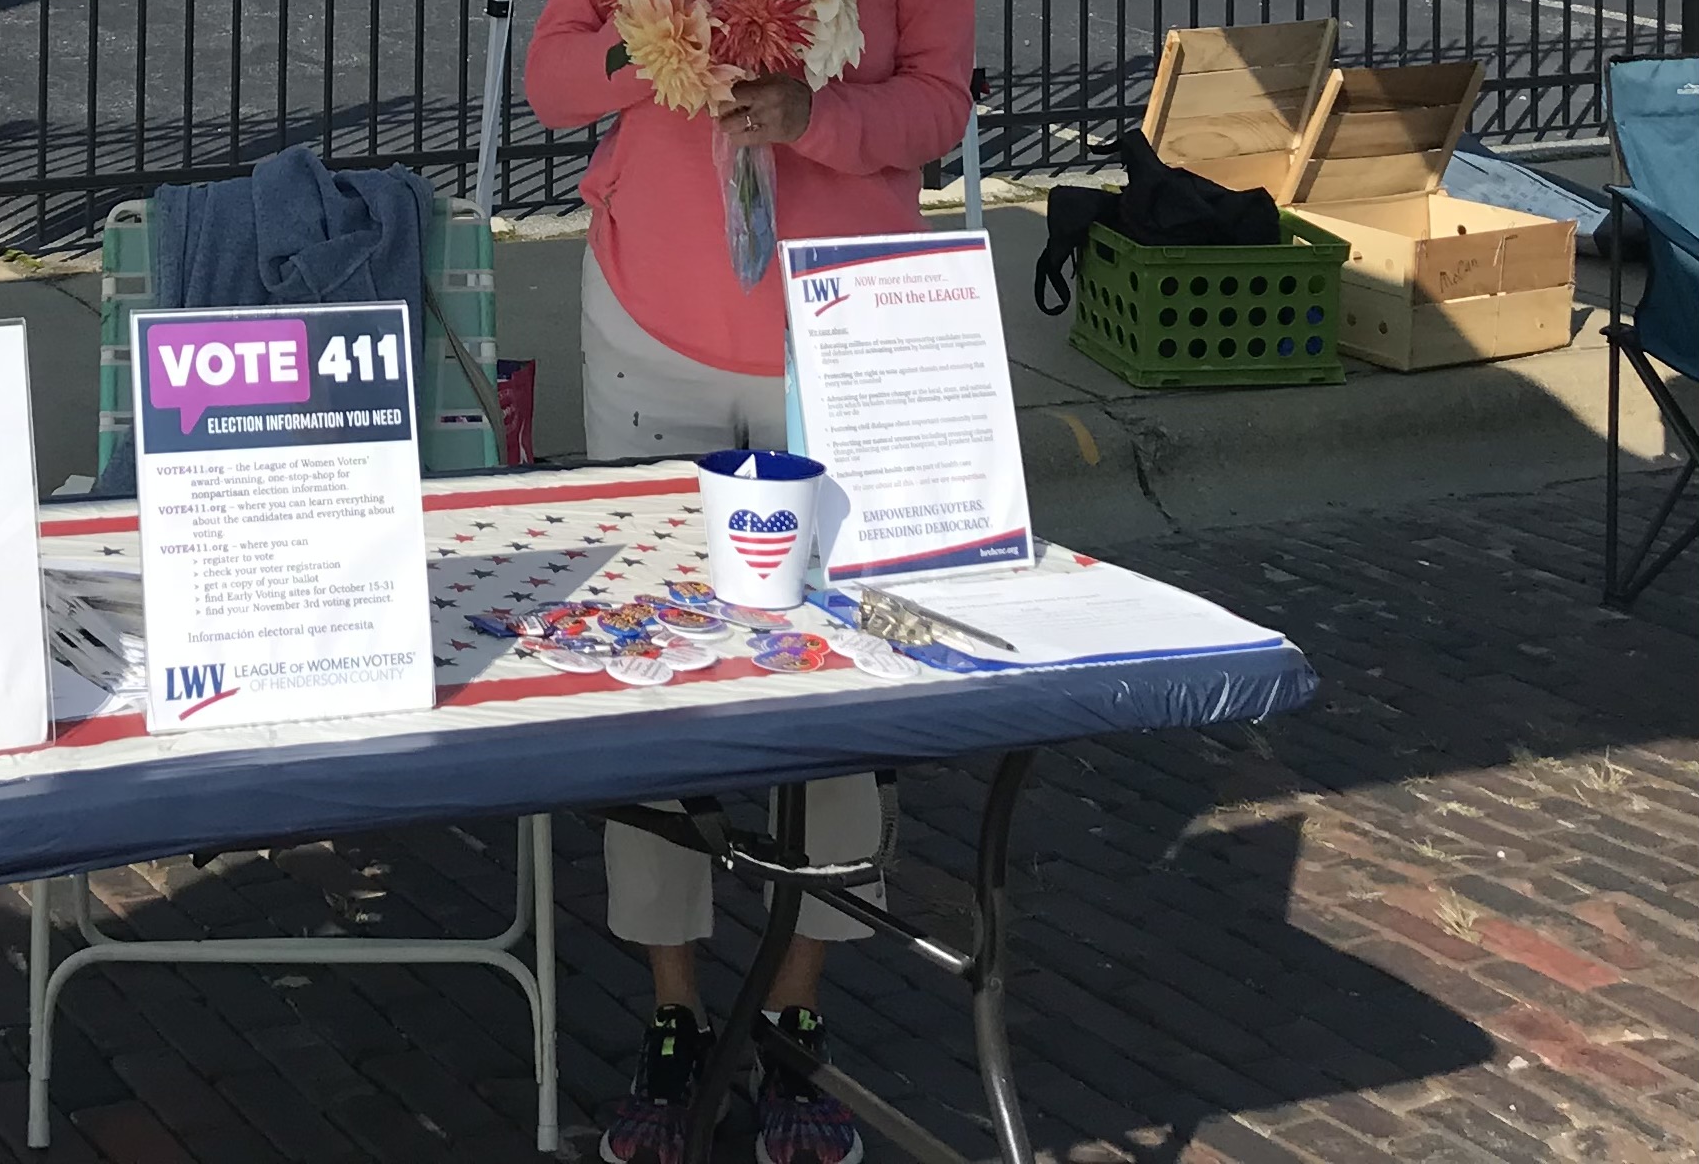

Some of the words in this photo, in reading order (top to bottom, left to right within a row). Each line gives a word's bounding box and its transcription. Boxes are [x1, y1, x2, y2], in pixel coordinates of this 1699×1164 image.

[802, 277, 841, 304] LWV
[854, 276, 877, 287] NOW
[878, 276, 901, 285] more
[902, 273, 923, 284] than
[874, 292, 903, 308] JOIN
[905, 290, 925, 304] the
[928, 287, 980, 302] LEAGUE.
[158, 341, 299, 386] VOTE
[318, 334, 399, 382] 411
[207, 416, 263, 434] ELECTION
[266, 412, 344, 430] INFORMATION
[346, 410, 370, 427] YOU
[372, 409, 402, 425] NEED
[156, 465, 225, 475] VOTE411.org
[235, 462, 251, 472] the
[254, 462, 287, 472] League
[289, 459, 299, 469] of
[300, 459, 335, 468] Women
[268, 471, 335, 483] one-stop-shop
[337, 469, 350, 479] for
[191, 489, 250, 501] nonpartisan
[252, 486, 289, 495] election
[158, 504, 227, 515] VOTE411.org
[237, 501, 266, 510] where
[268, 501, 286, 511] you
[288, 500, 306, 508] can
[309, 497, 333, 506] learn
[336, 494, 385, 506] everything
[862, 503, 939, 522] EMPOWERING
[940, 499, 985, 514] VOTERS.
[192, 516, 220, 526] about
[223, 515, 239, 524] the
[241, 512, 293, 523] candidates
[295, 509, 314, 520] and
[316, 507, 366, 519] everything
[368, 505, 395, 515] about
[858, 524, 923, 541] DEFENDING
[924, 517, 993, 534] DEMOCRACY.
[160, 544, 229, 554] VOTE411.org
[239, 540, 268, 549] where
[271, 540, 288, 550] you
[203, 555, 239, 566] register
[242, 554, 252, 562] to
[254, 553, 274, 561] vote
[203, 567, 232, 577] check
[235, 567, 257, 577] your
[260, 565, 284, 573] voter
[286, 562, 341, 573] registration
[204, 582, 218, 593] get
[230, 580, 253, 590] copy
[256, 576, 265, 587] of
[267, 578, 289, 588] your
[292, 574, 319, 584] ballot
[204, 592, 224, 603] find
[227, 591, 253, 602] Early
[255, 590, 287, 600] Voting
[288, 588, 311, 597] sites
[313, 585, 327, 595] for
[328, 583, 365, 594] October
[205, 605, 225, 616] find
[227, 606, 249, 616] your
[253, 601, 300, 612] November
[303, 598, 320, 608] 3rd
[322, 597, 351, 608] voting
[353, 594, 393, 607] precinct.
[188, 629, 255, 643] Información
[258, 624, 304, 638] electoral
[307, 625, 327, 637] que
[330, 621, 374, 633] necesita
[234, 662, 286, 678] LEAGUE
[289, 663, 304, 674] OF
[306, 657, 360, 672] WOMEN
[165, 663, 226, 702] LWV
[249, 678, 268, 693] OF
[269, 672, 347, 691] HENDERSON
[348, 667, 404, 684] COUNTY
